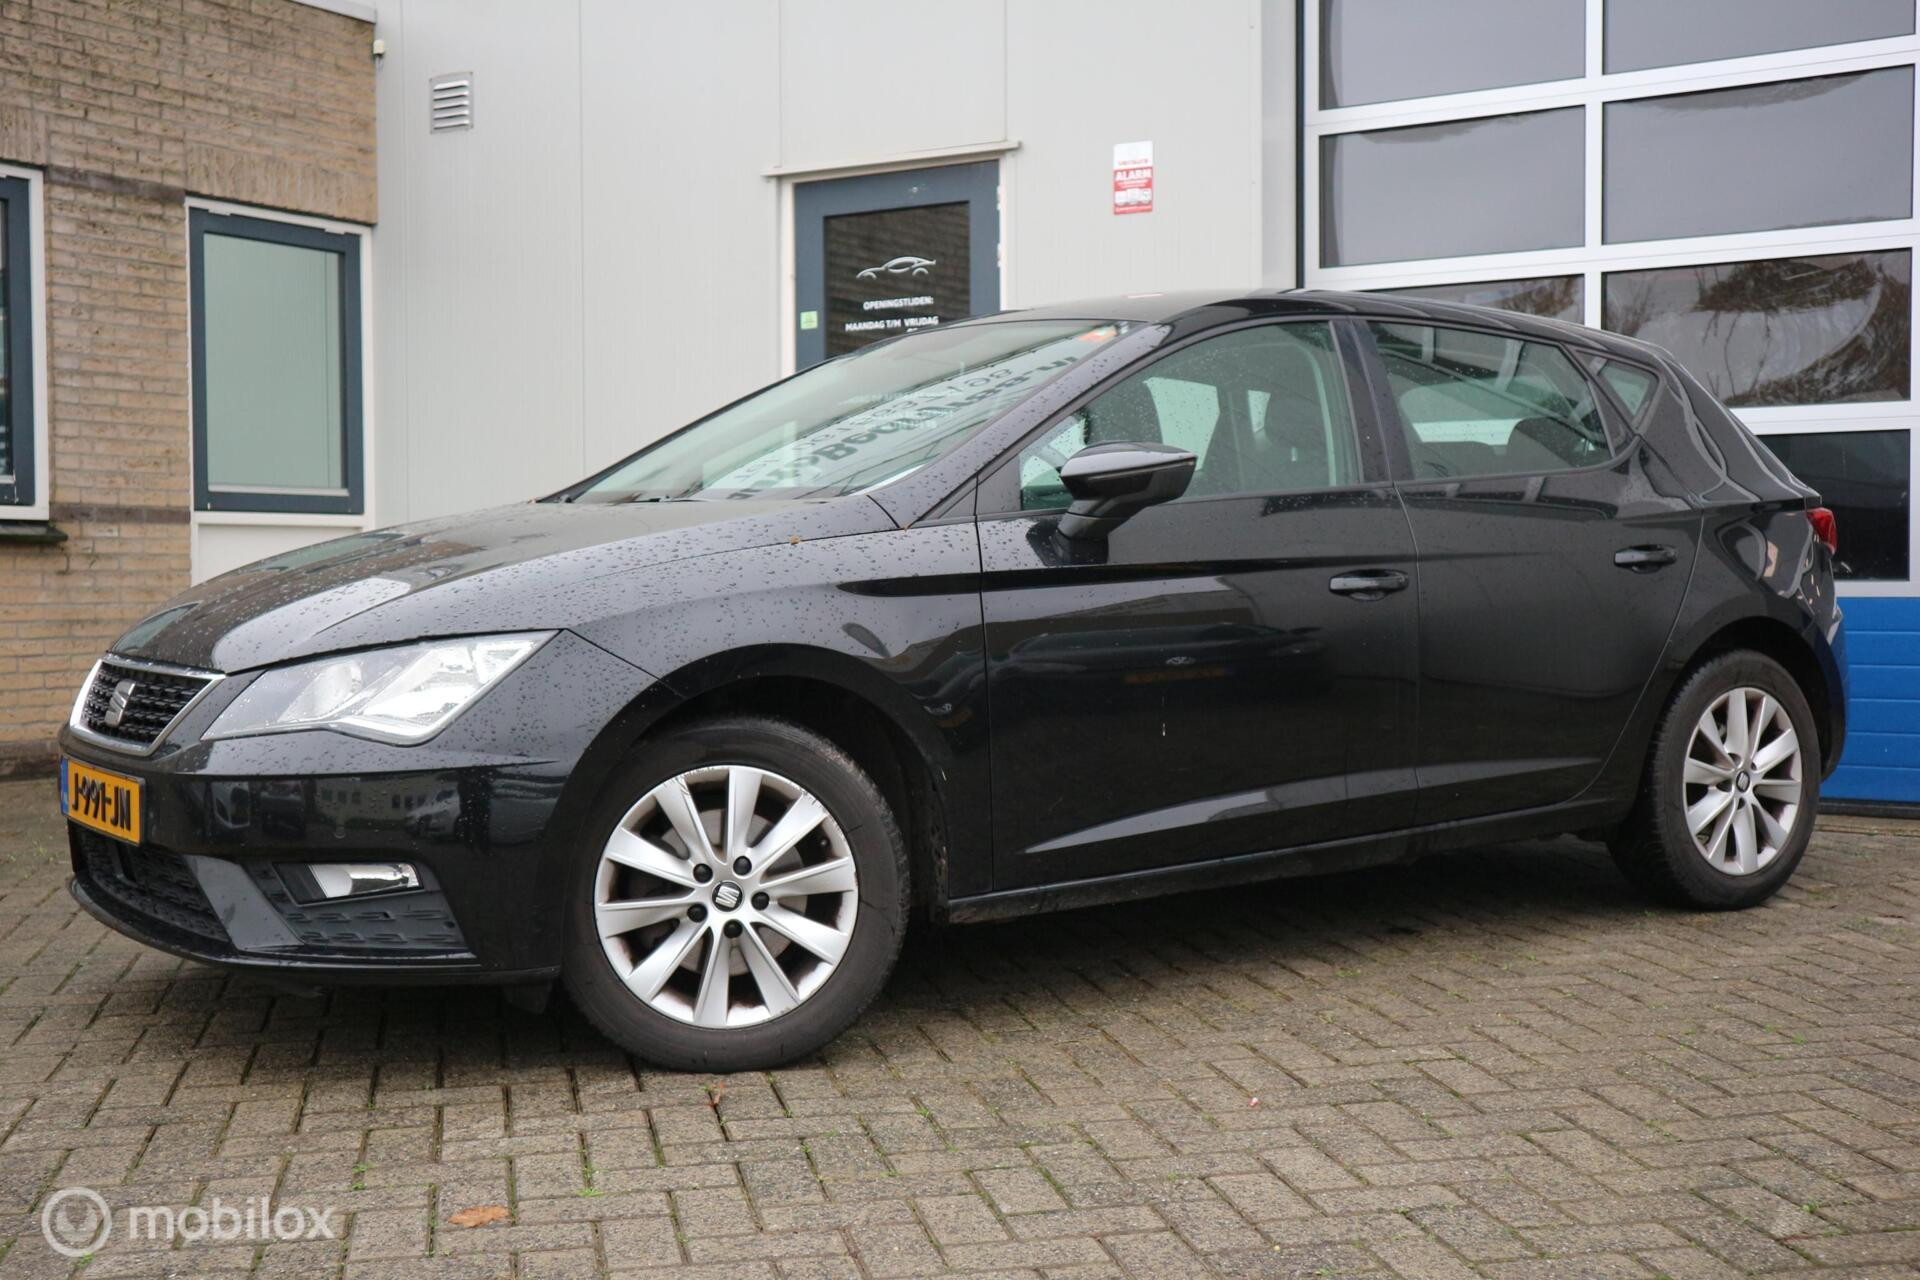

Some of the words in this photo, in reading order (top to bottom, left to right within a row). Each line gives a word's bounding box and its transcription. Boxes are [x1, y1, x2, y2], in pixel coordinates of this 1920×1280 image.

[1115, 169, 1151, 181] ALARM
[863, 296, 934, 311] OPENINGSTIJDEN:
[845, 320, 885, 332] MAANDAG
[886, 318, 901, 328] T/M
[904, 316, 939, 327] VRIJDAG
[72, 773, 131, 832] J-991-JN
